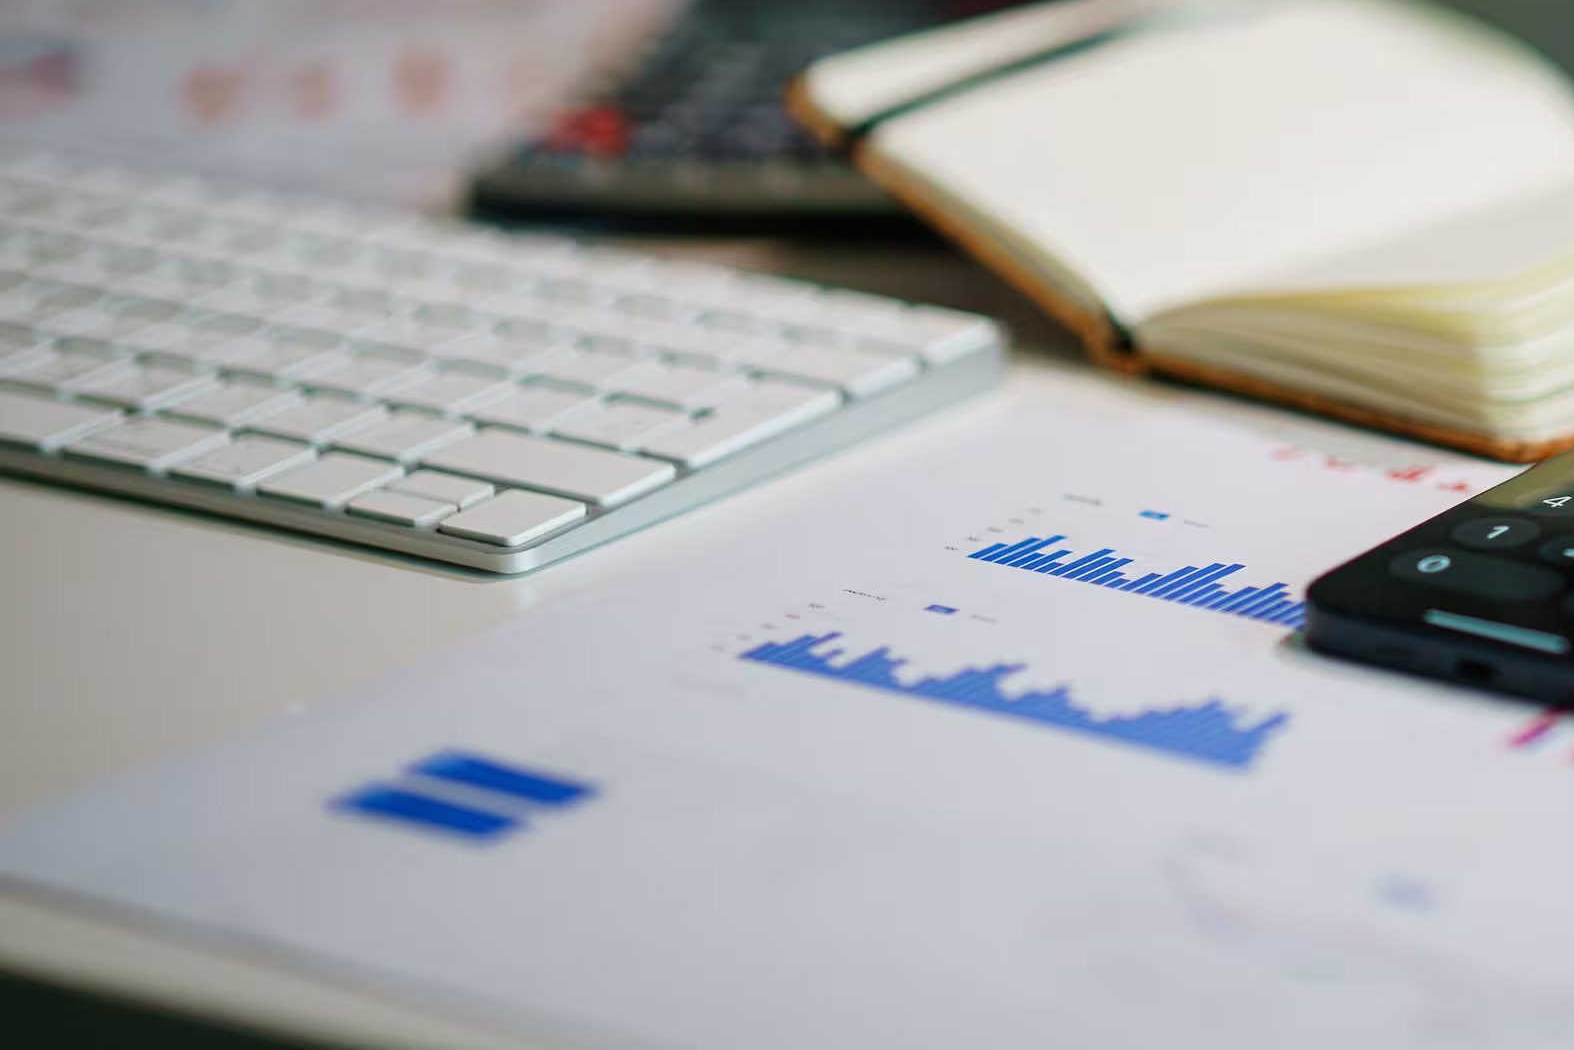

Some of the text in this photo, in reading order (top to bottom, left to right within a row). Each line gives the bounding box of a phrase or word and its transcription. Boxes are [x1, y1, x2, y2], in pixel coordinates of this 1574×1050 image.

[1542, 495, 1573, 508] 4
[1486, 524, 1510, 540] 1
[1416, 554, 1451, 573] 0
